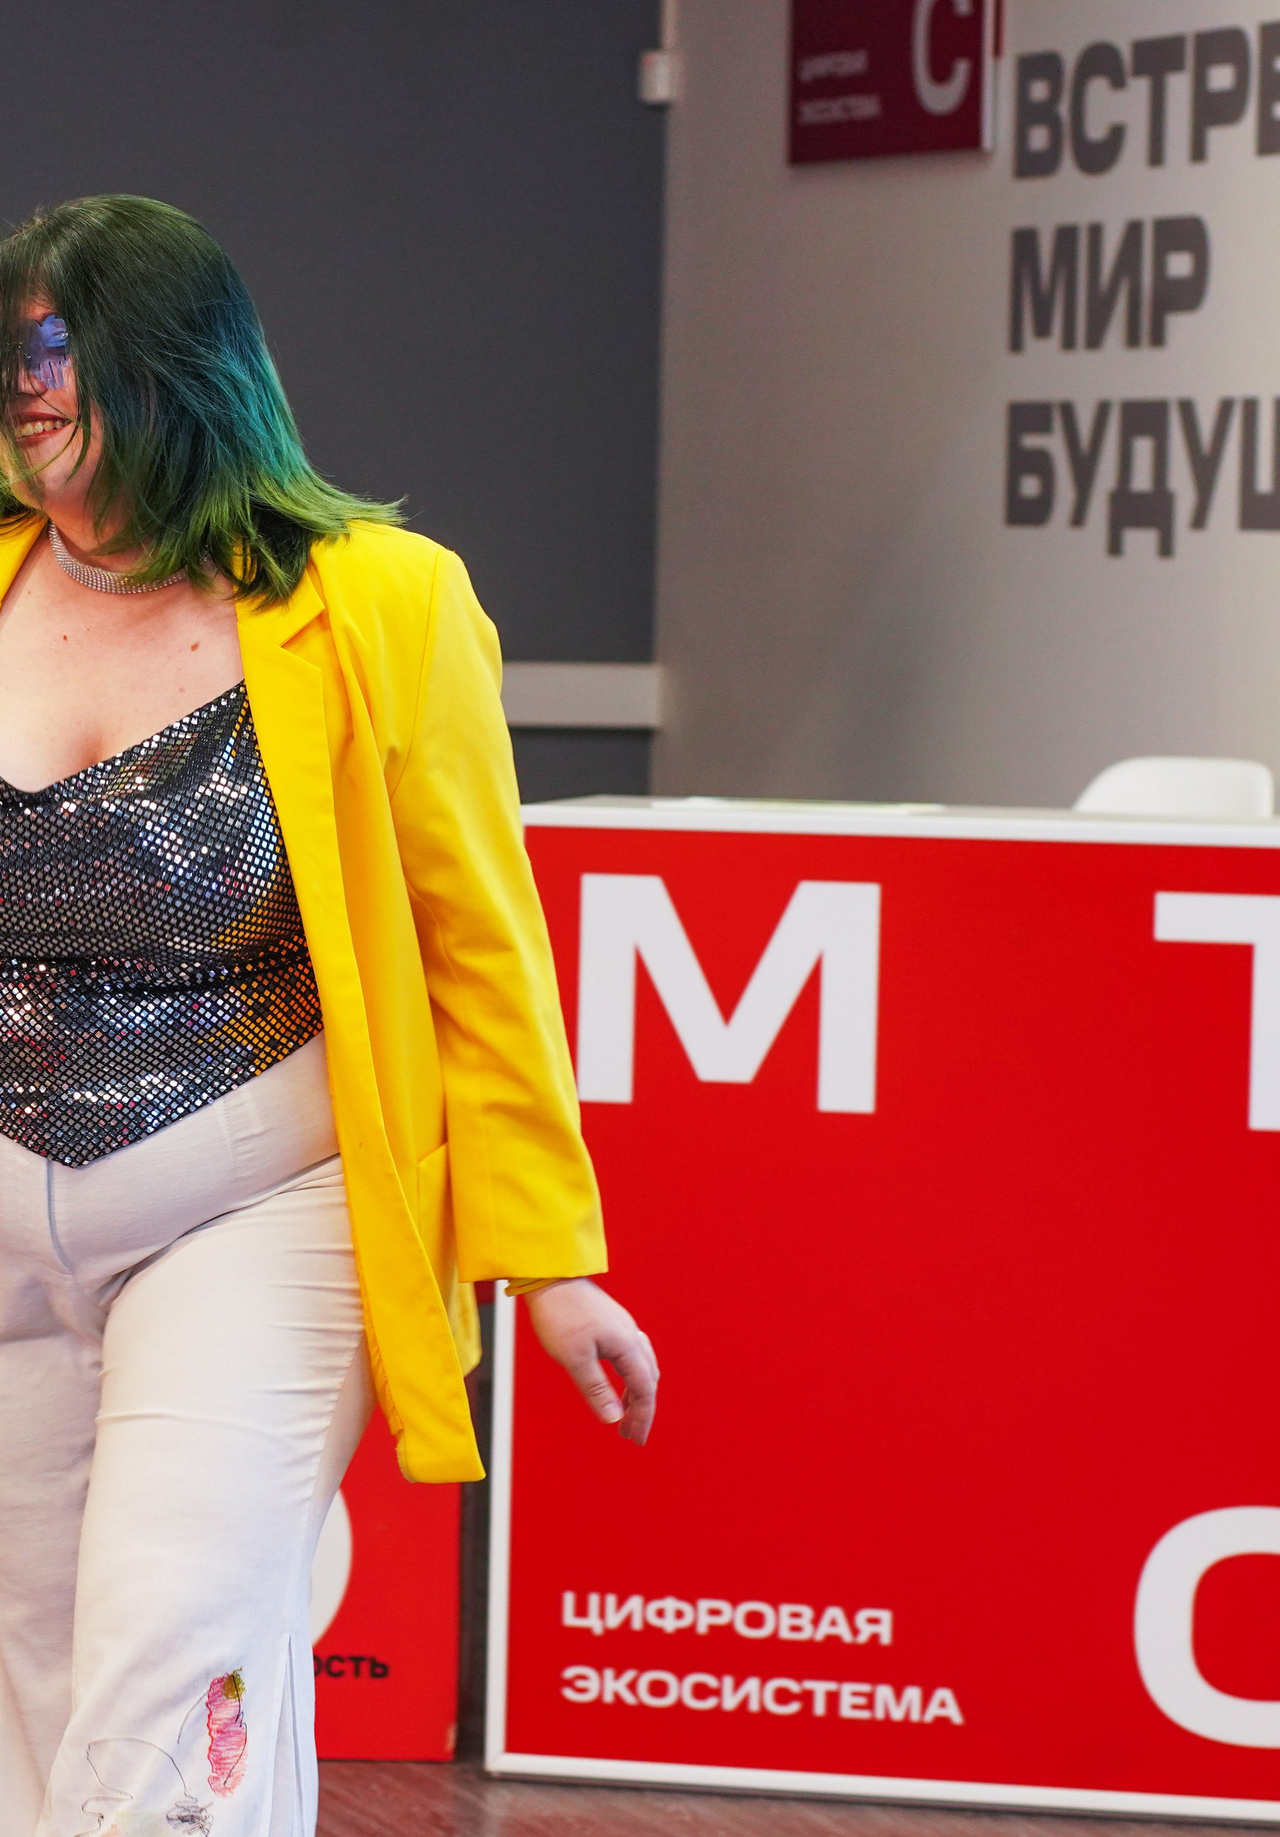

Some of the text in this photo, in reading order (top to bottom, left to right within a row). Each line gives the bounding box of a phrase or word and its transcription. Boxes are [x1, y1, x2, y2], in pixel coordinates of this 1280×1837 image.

[1009, 214, 1210, 354] МИР
[577, 872, 882, 1114] М
[561, 1590, 894, 1646] ЦИФРОВАЯ
[560, 1664, 966, 1727] ЭКОСИСТЕМА
